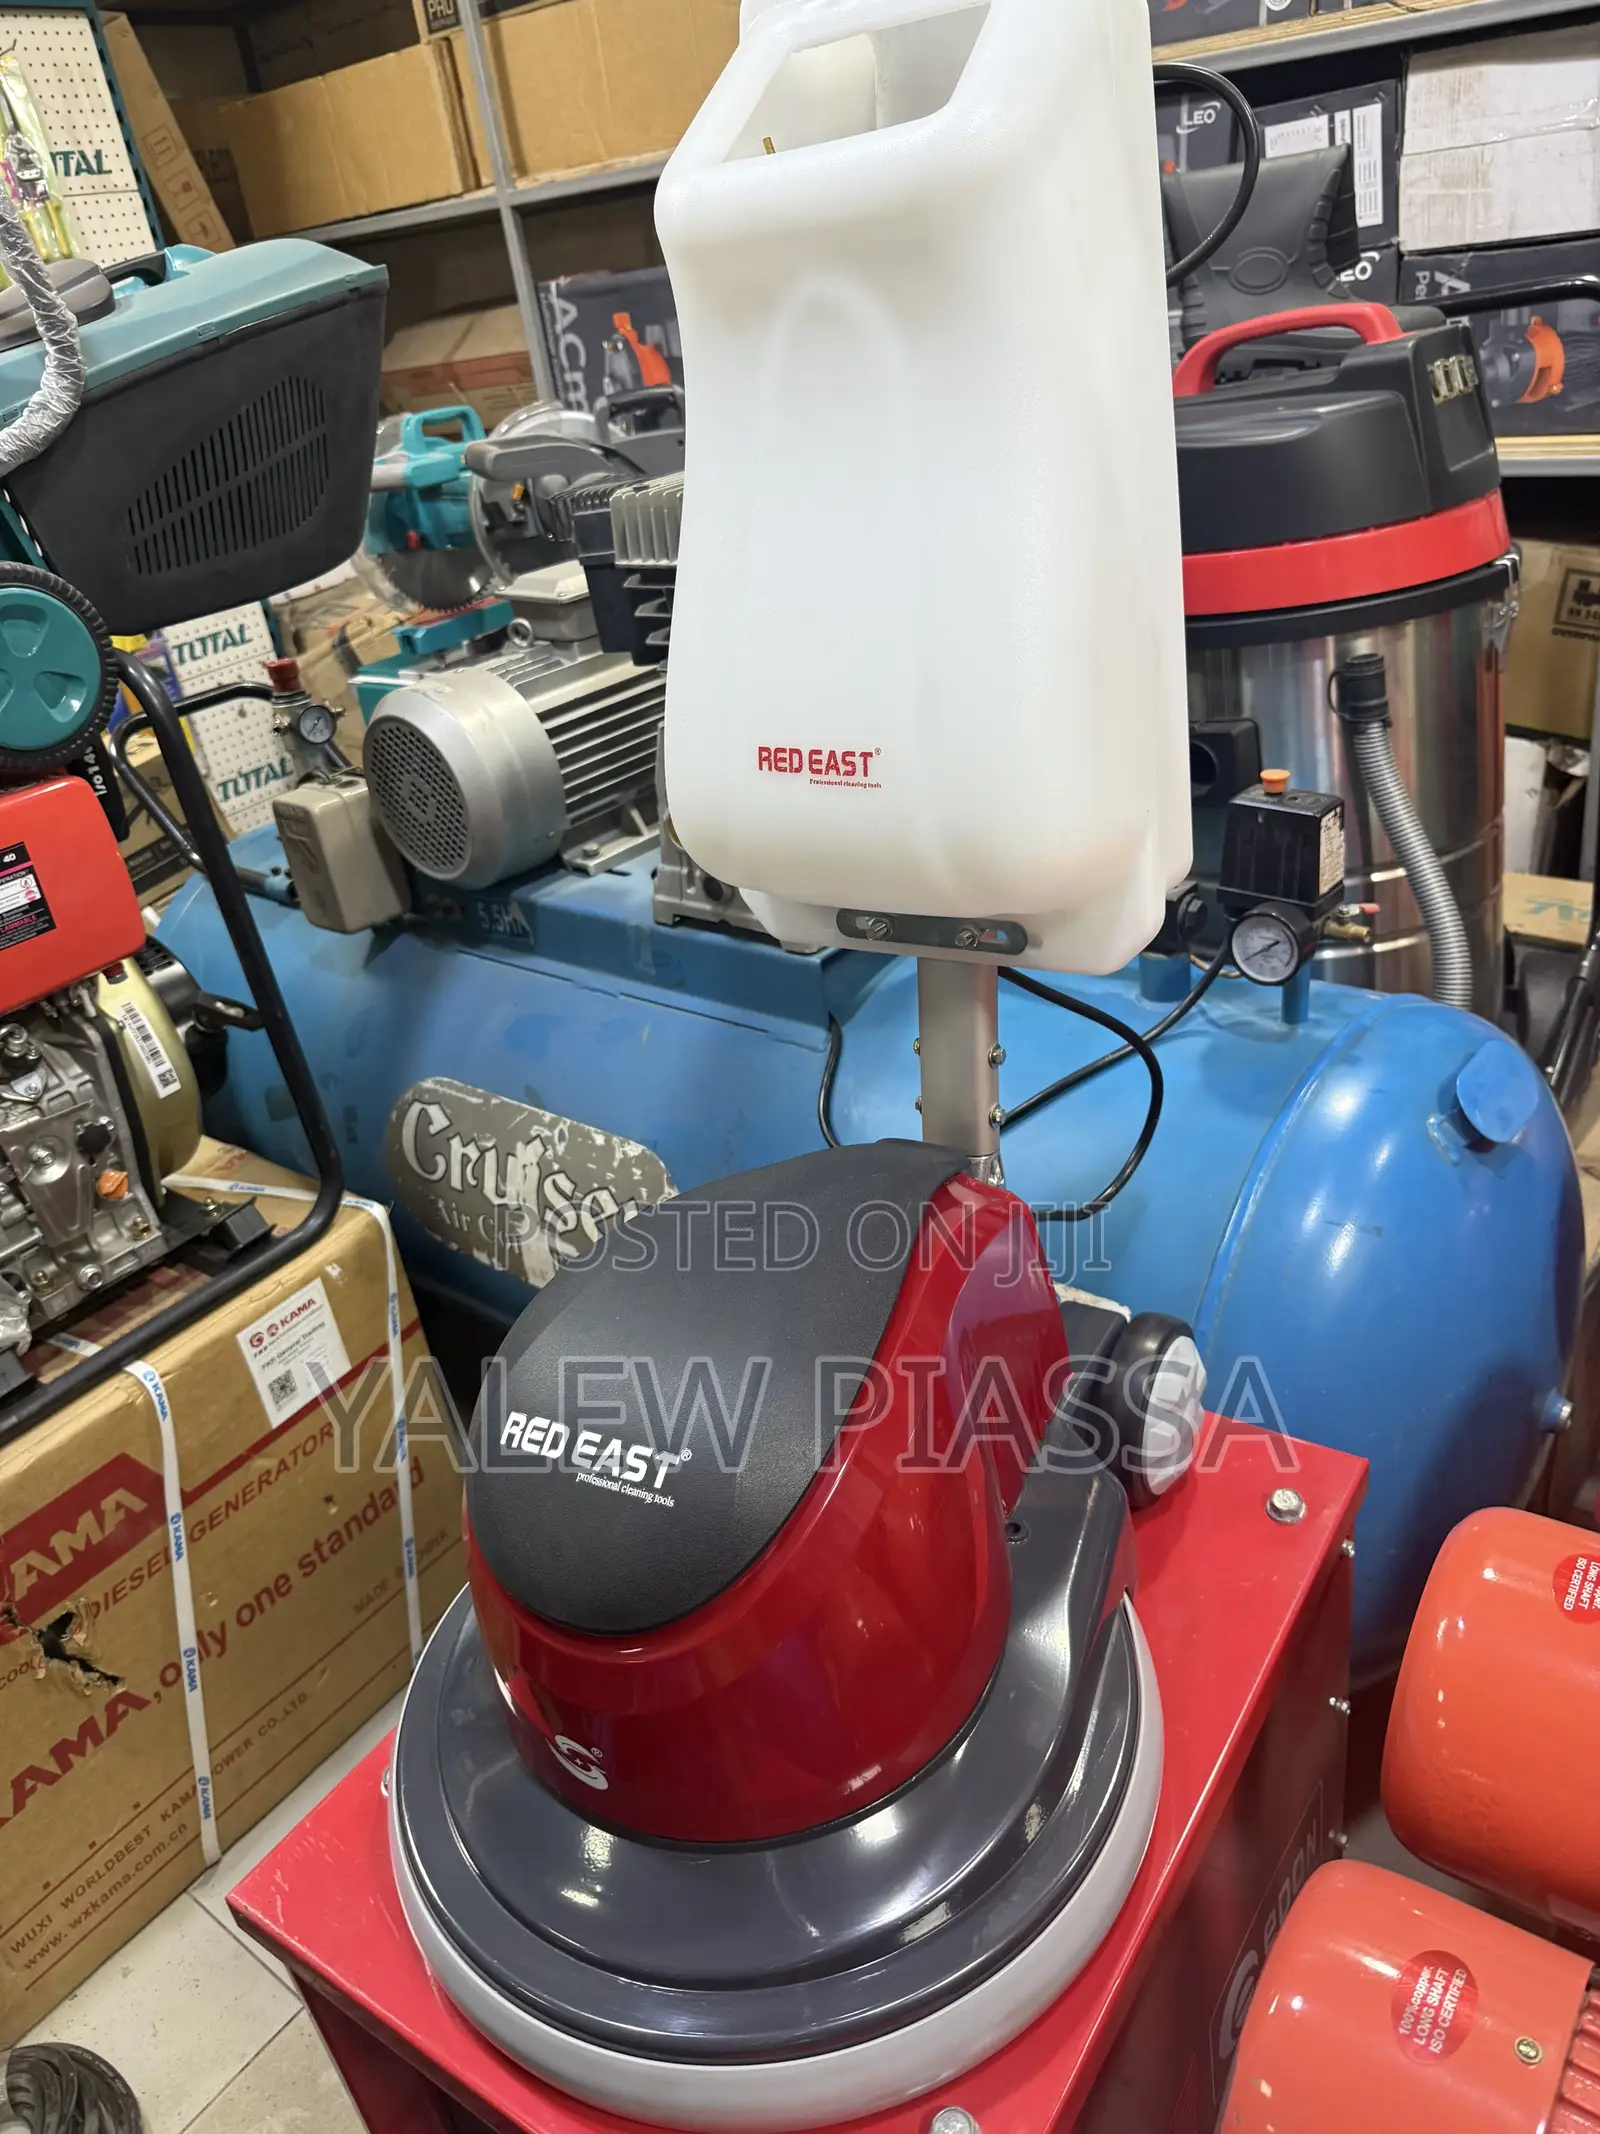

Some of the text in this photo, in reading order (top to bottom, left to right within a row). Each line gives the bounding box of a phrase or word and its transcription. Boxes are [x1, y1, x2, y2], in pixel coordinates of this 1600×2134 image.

[1182, 108, 1217, 126] LEO
[758, 746, 804, 774] RED
[280, 1298, 317, 1328] KAMA
[152, 1383, 169, 1422] KAMA
[499, 1411, 571, 1460] RED
[189, 1421, 335, 1544] GENERATOR
[576, 1472, 675, 1508] professional cleaning tools
[172, 1524, 185, 1562] KAMA
[235, 1572, 293, 1629] one
[1563, 1569, 1584, 1611] CERTIFIED
[1578, 1581, 1595, 1610] SHAFT
[186, 1657, 199, 1693] KAMA
[10, 1913, 54, 1955] WUXI
[59, 1823, 152, 1911] WORLDBEST
[210, 1737, 254, 1777] OWER
[1413, 1967, 1451, 2046] LONG SHAFT
[1428, 1968, 1468, 2054] ISO CERTIFIED
